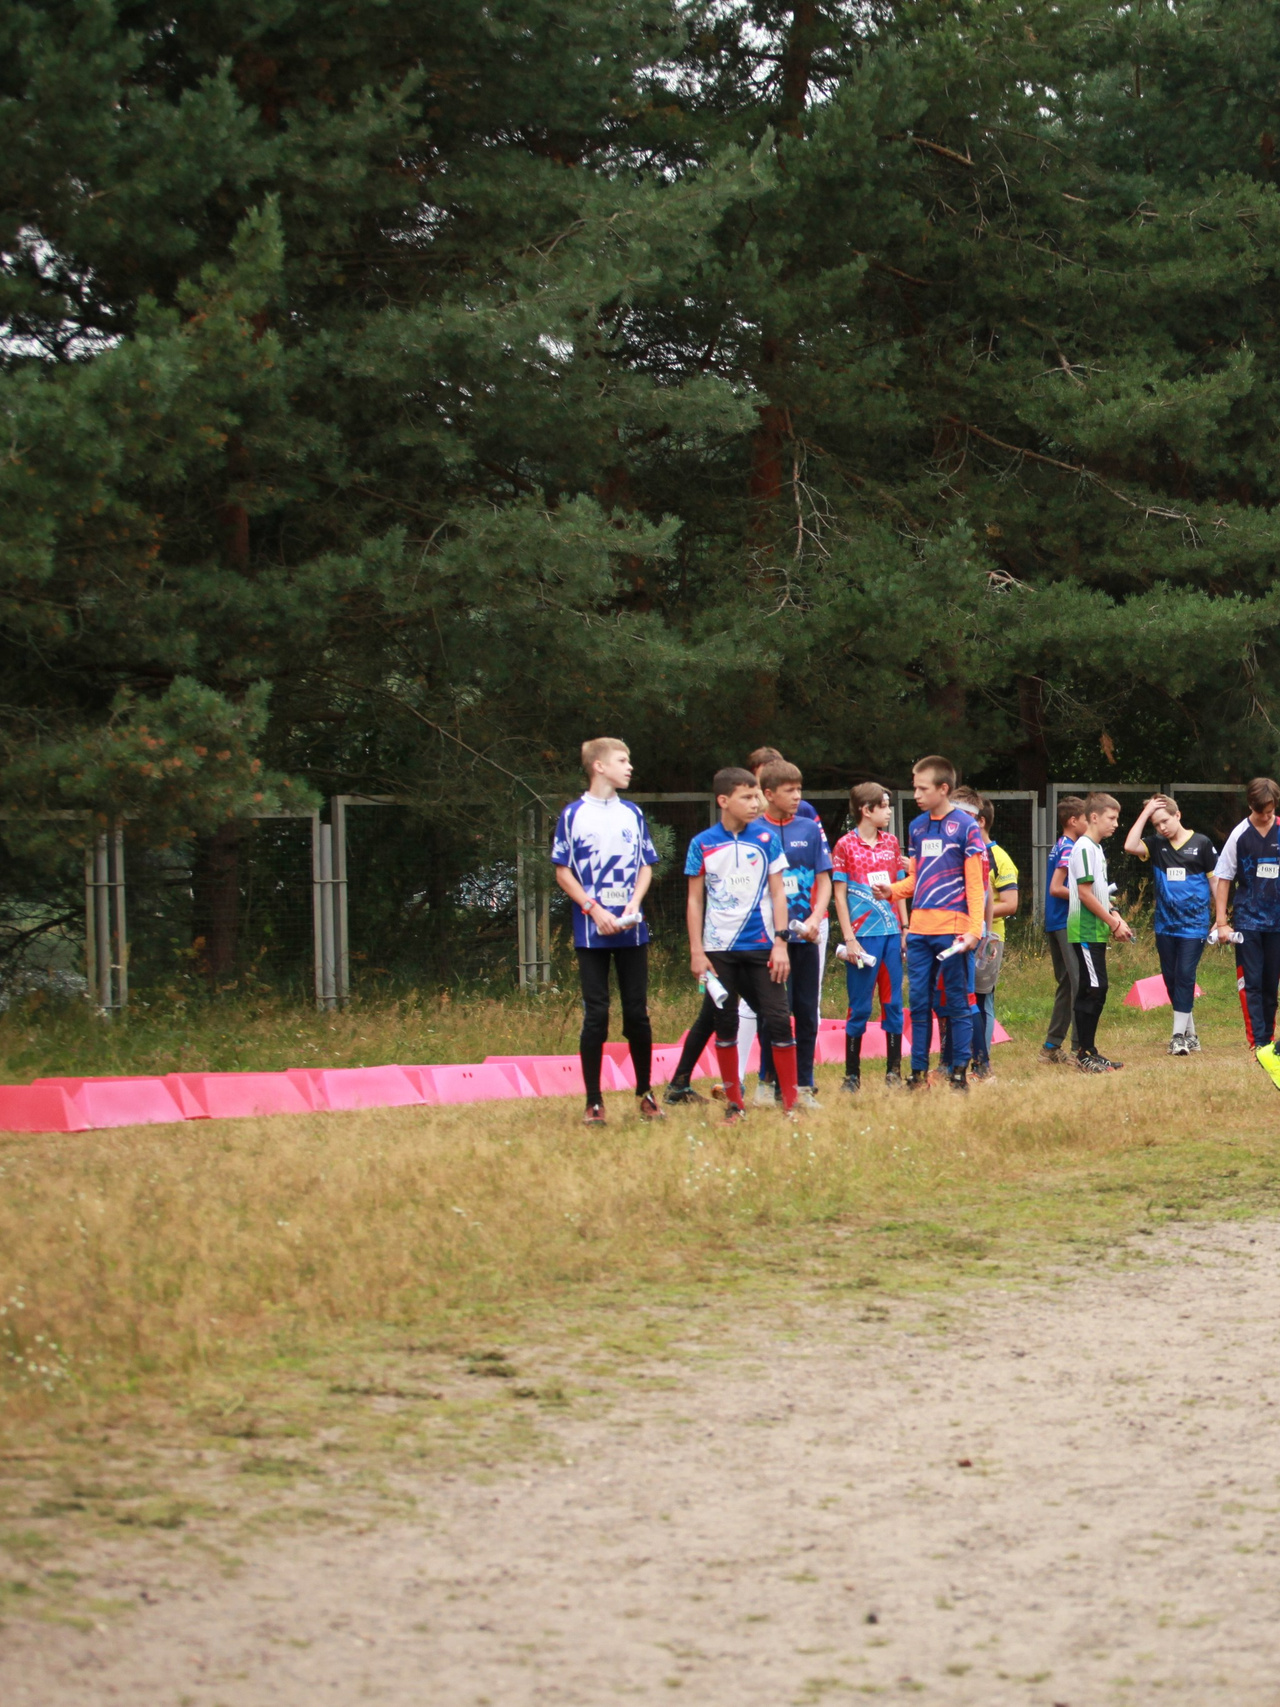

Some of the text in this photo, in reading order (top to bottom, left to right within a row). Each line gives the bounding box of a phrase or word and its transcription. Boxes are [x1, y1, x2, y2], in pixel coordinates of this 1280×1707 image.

[924, 842, 939, 850] 1035
[730, 876, 750, 886] 1005
[871, 873, 887, 882] 1072
[606, 891, 625, 899] 1004
